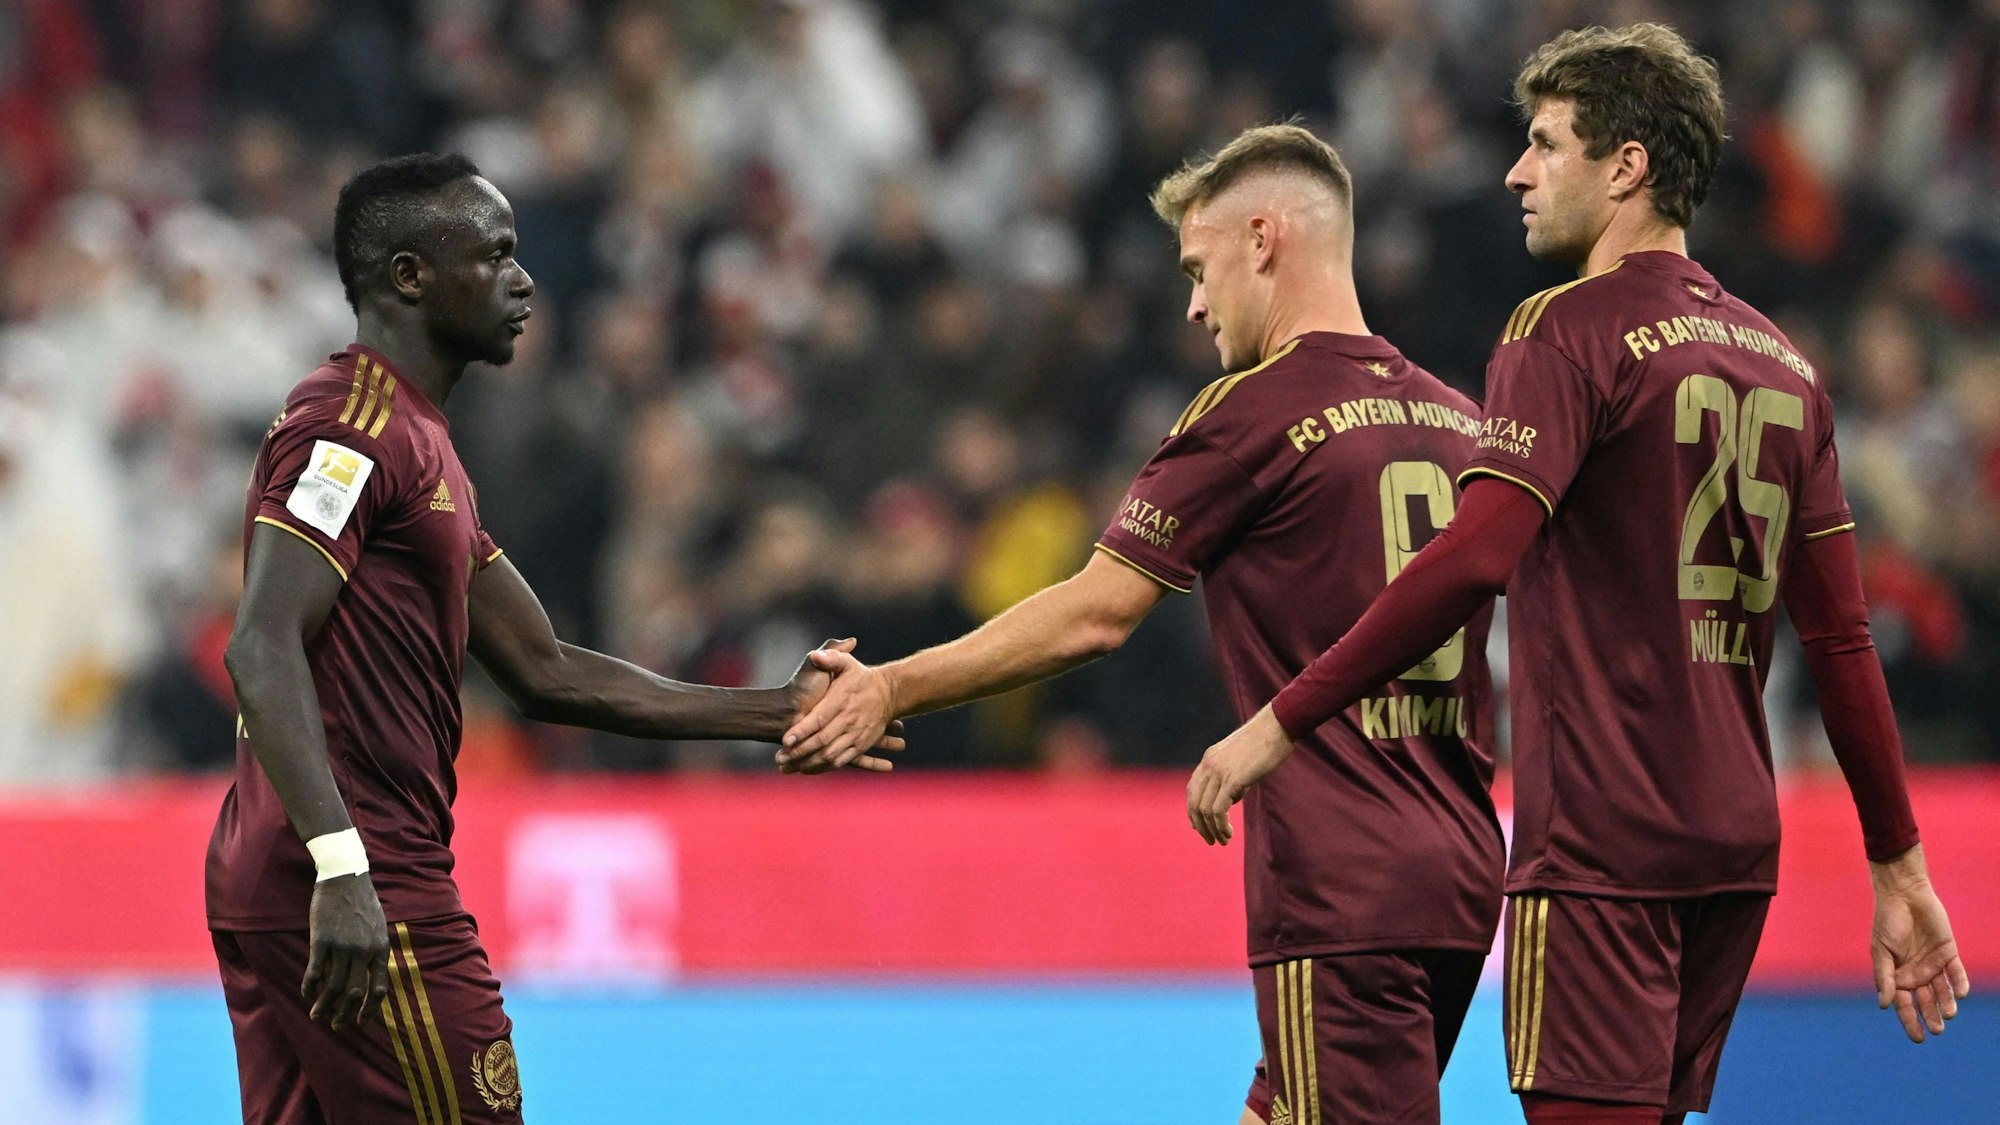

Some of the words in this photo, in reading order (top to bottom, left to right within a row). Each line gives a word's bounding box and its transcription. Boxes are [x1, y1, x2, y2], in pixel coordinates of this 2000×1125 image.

[1624, 326, 1661, 361] FC
[1656, 316, 1731, 347] BAYERN
[1286, 417, 1326, 453] FC
[1323, 398, 1408, 434] BAYERN
[1479, 417, 1537, 448] ATAR
[1476, 436, 1532, 459] AIRWAYS
[313, 474, 348, 494] BUNDESLIGA
[1674, 373, 1804, 614] 25
[429, 500, 456, 513] adidas
[1117, 516, 1172, 551] AIRWAYS
[1690, 609, 1755, 666] MÜLL
[1360, 694, 1468, 740] KIMMIC
